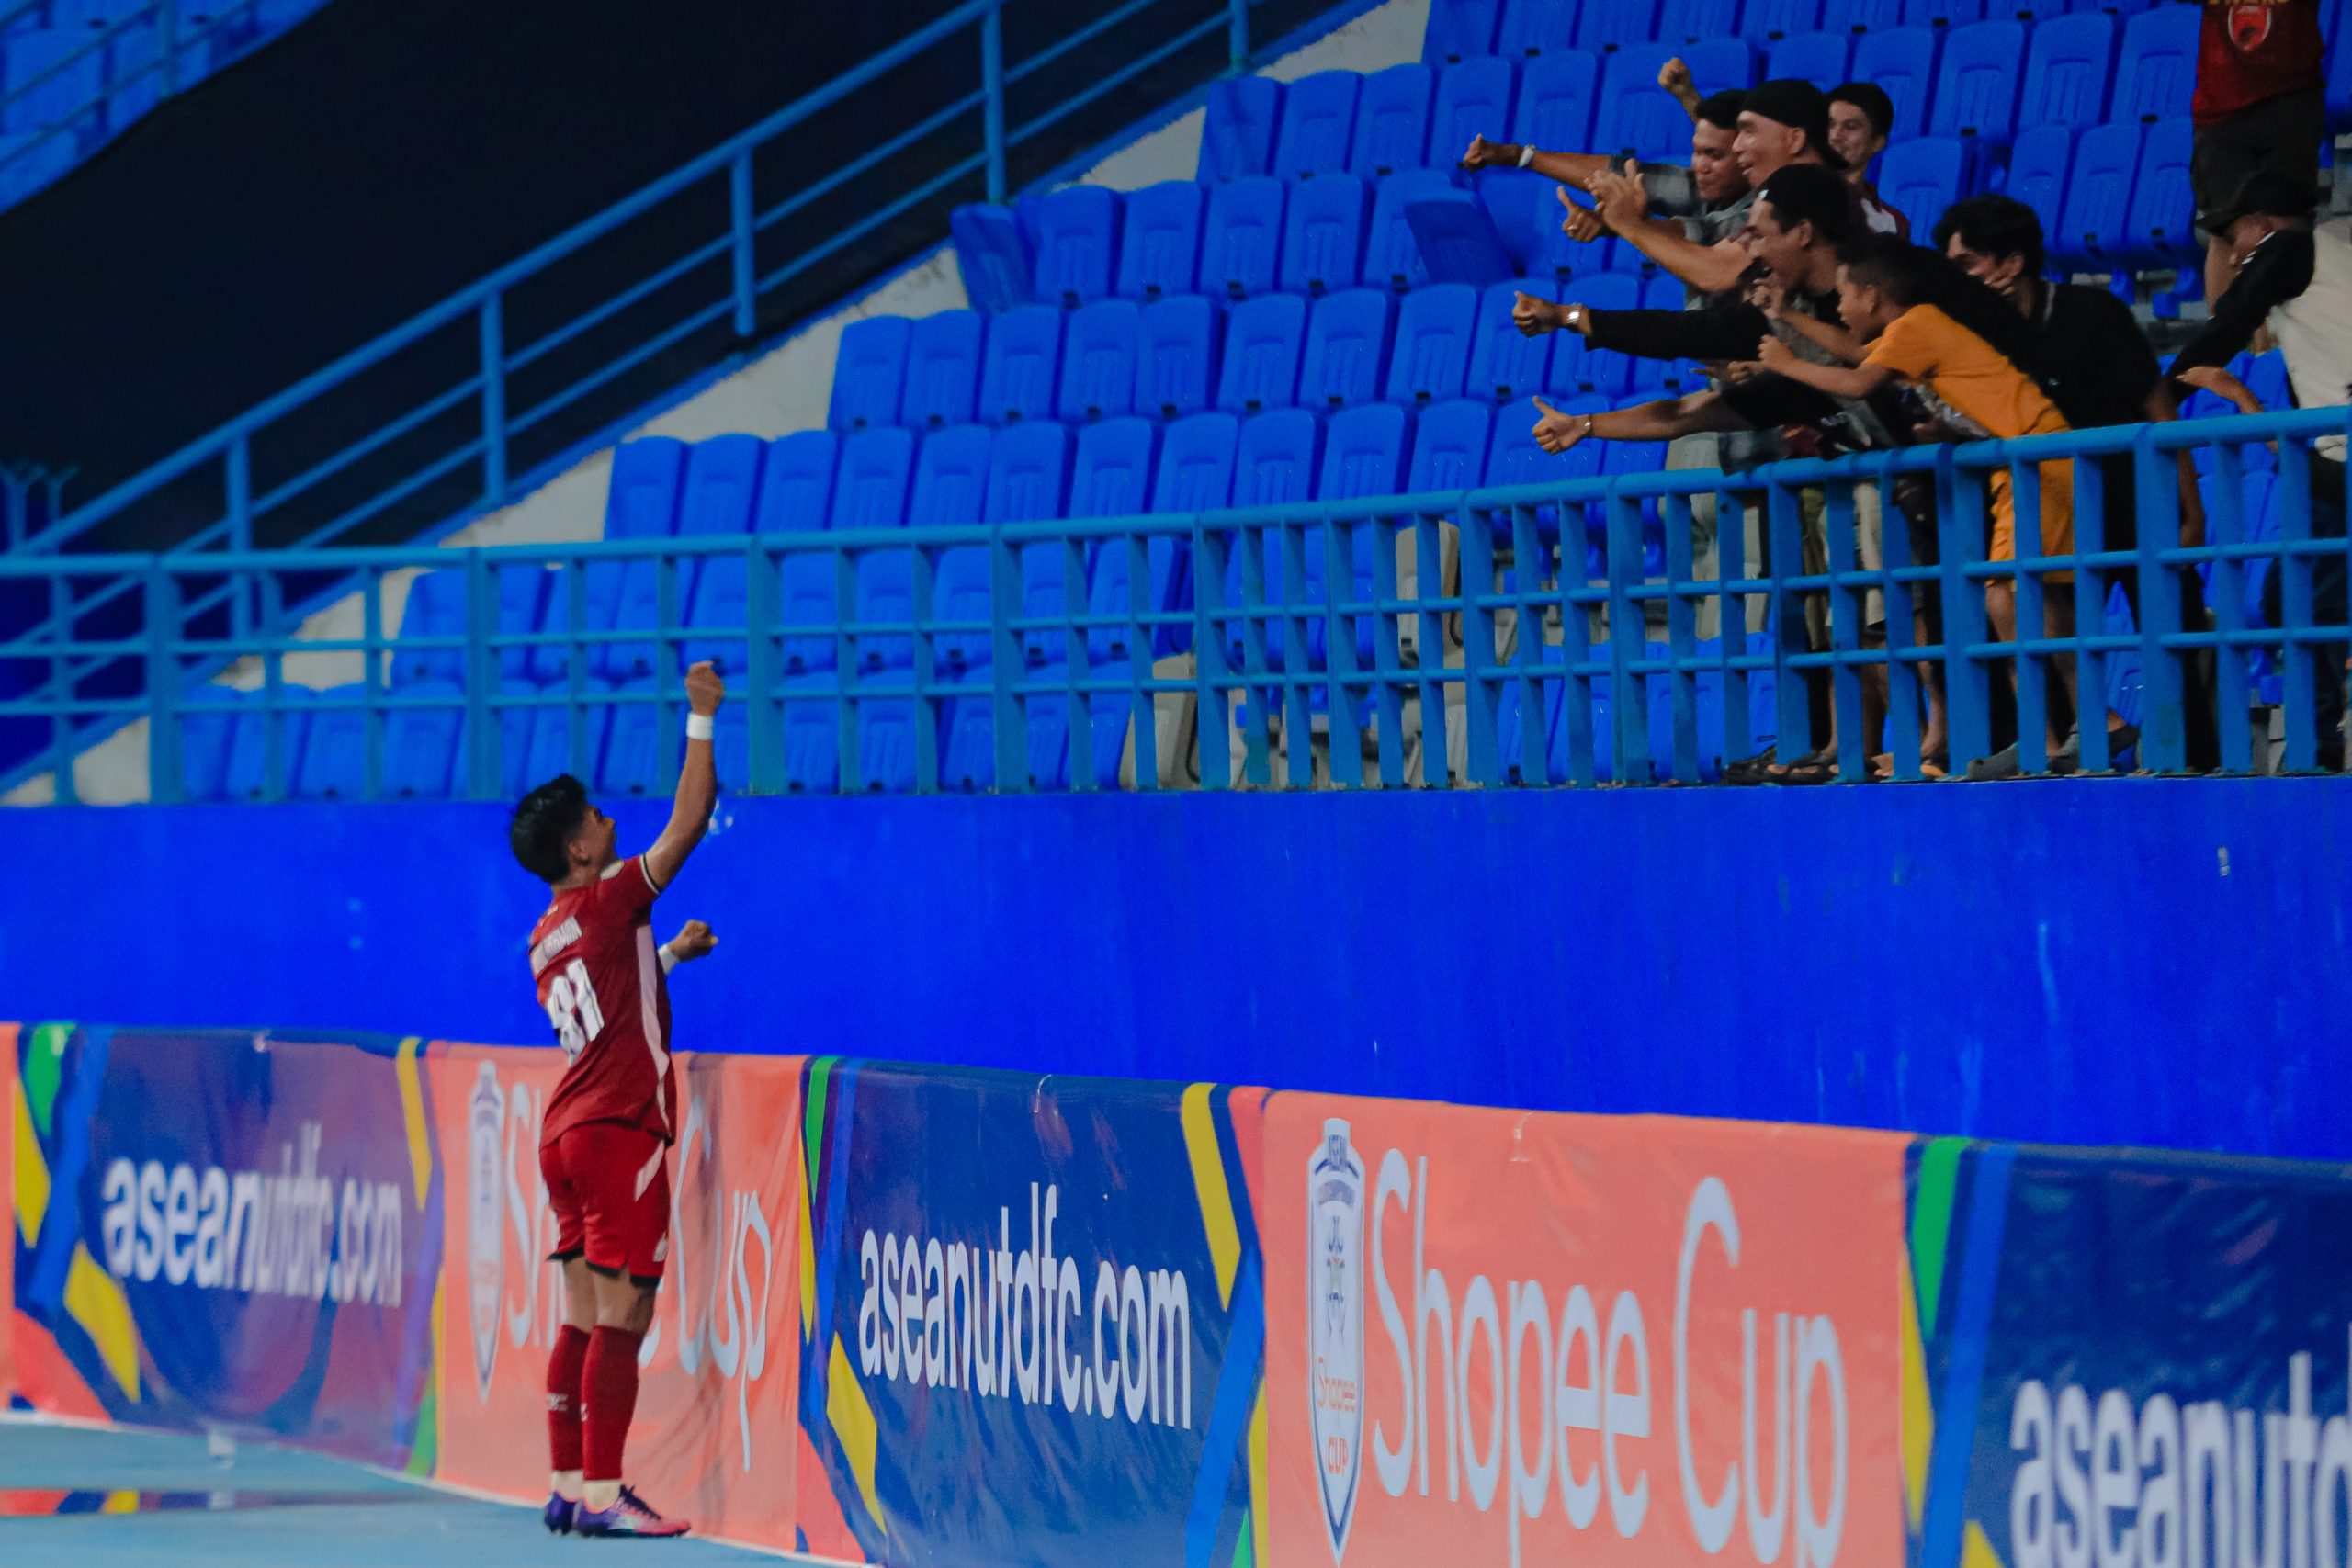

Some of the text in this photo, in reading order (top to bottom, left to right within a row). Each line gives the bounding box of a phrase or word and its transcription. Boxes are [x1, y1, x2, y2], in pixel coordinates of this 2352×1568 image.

[673, 1096, 772, 1472] Cup
[858, 1181, 1192, 1430] aseanutdfc.com
[1372, 1147, 1848, 1568] Shopee Cup
[1326, 1436, 1349, 1475] CUP
